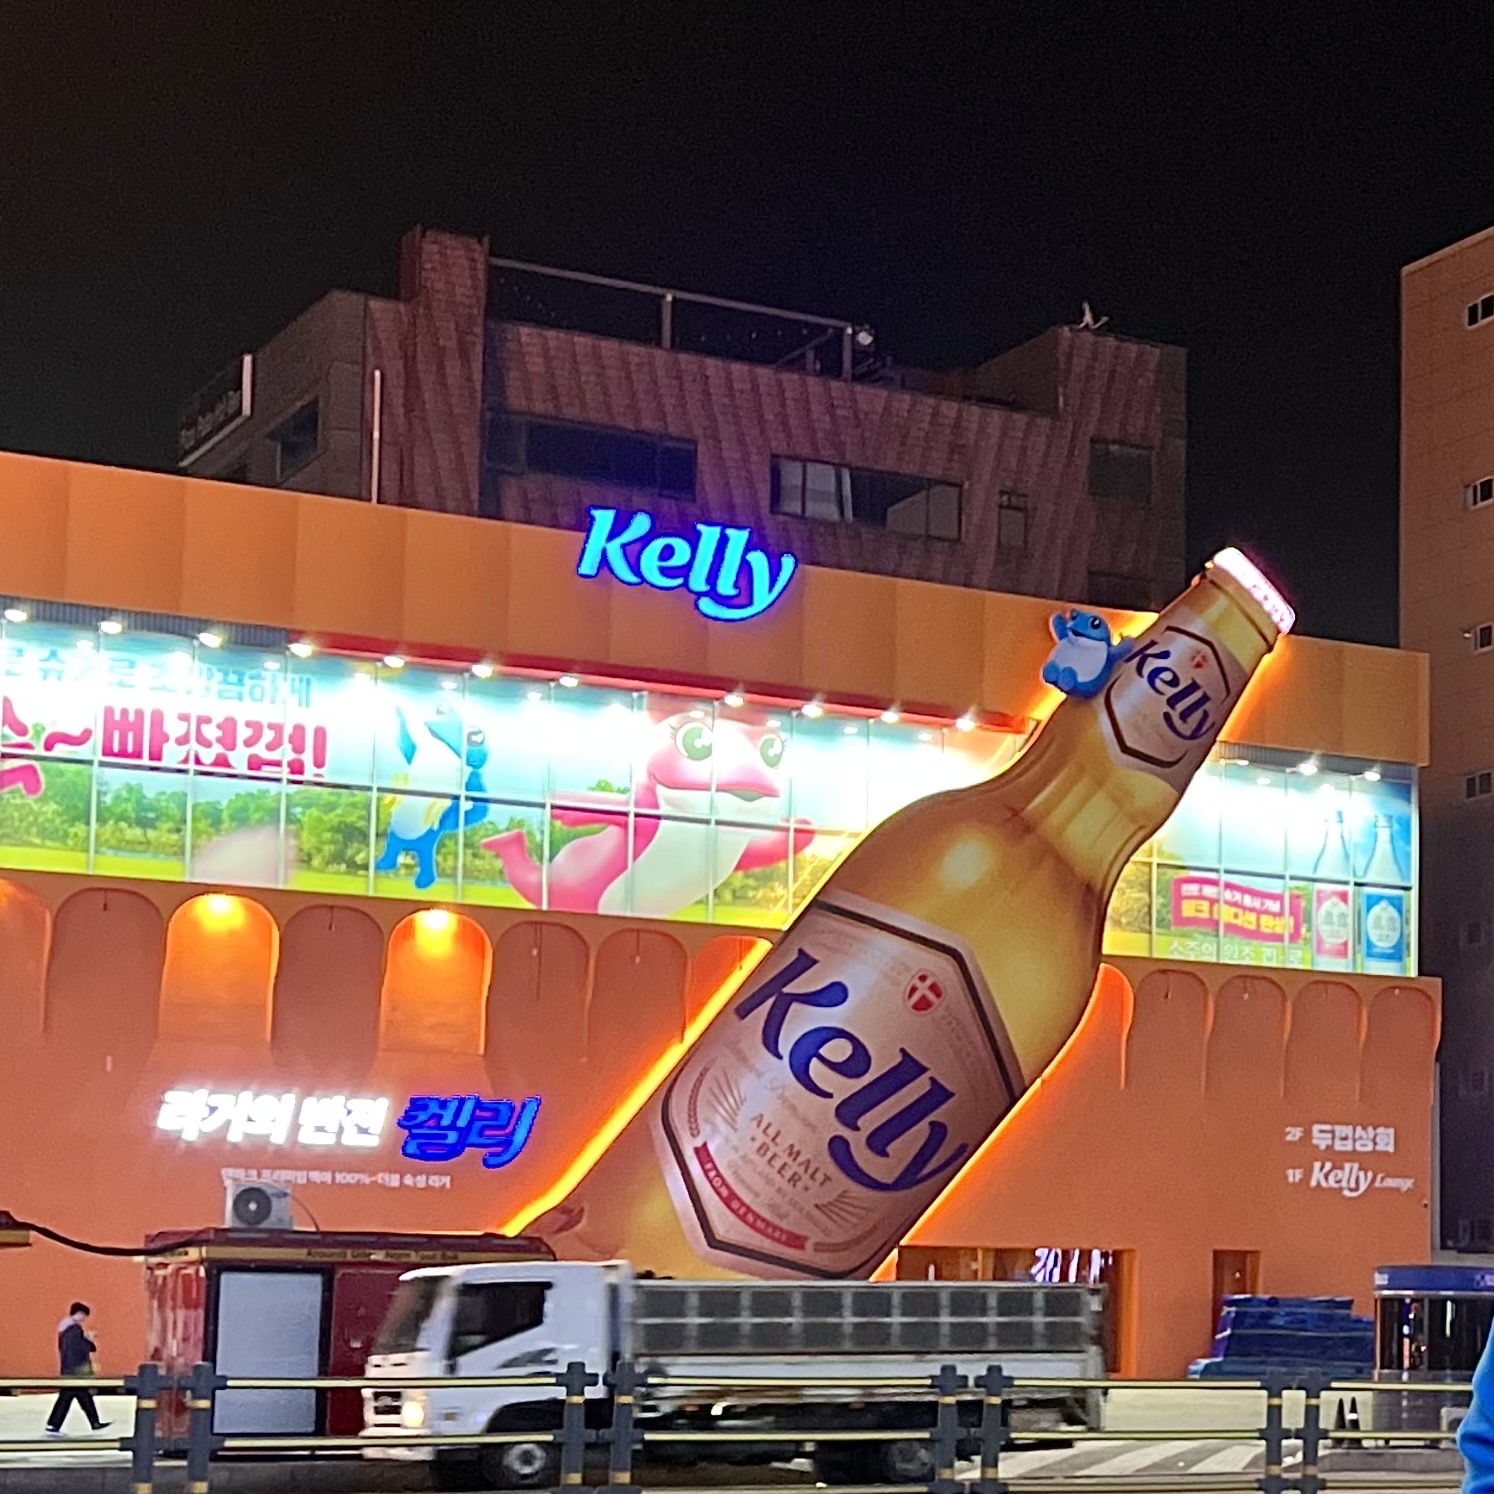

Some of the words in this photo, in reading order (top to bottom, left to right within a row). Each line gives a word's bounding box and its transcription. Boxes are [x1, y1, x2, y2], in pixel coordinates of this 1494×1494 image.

[578, 504, 797, 622] Kelly
[1122, 638, 1216, 741] Kelly
[733, 946, 969, 1192] Kelly
[397, 1093, 542, 1169] 켈리
[749, 1112, 782, 1147] ALL
[782, 1142, 833, 1186] MALT
[754, 1140, 804, 1189] BEER
[1285, 1126, 1304, 1142] 2F
[1285, 1168, 1304, 1184] 1F
[1309, 1160, 1374, 1197] Kelly
